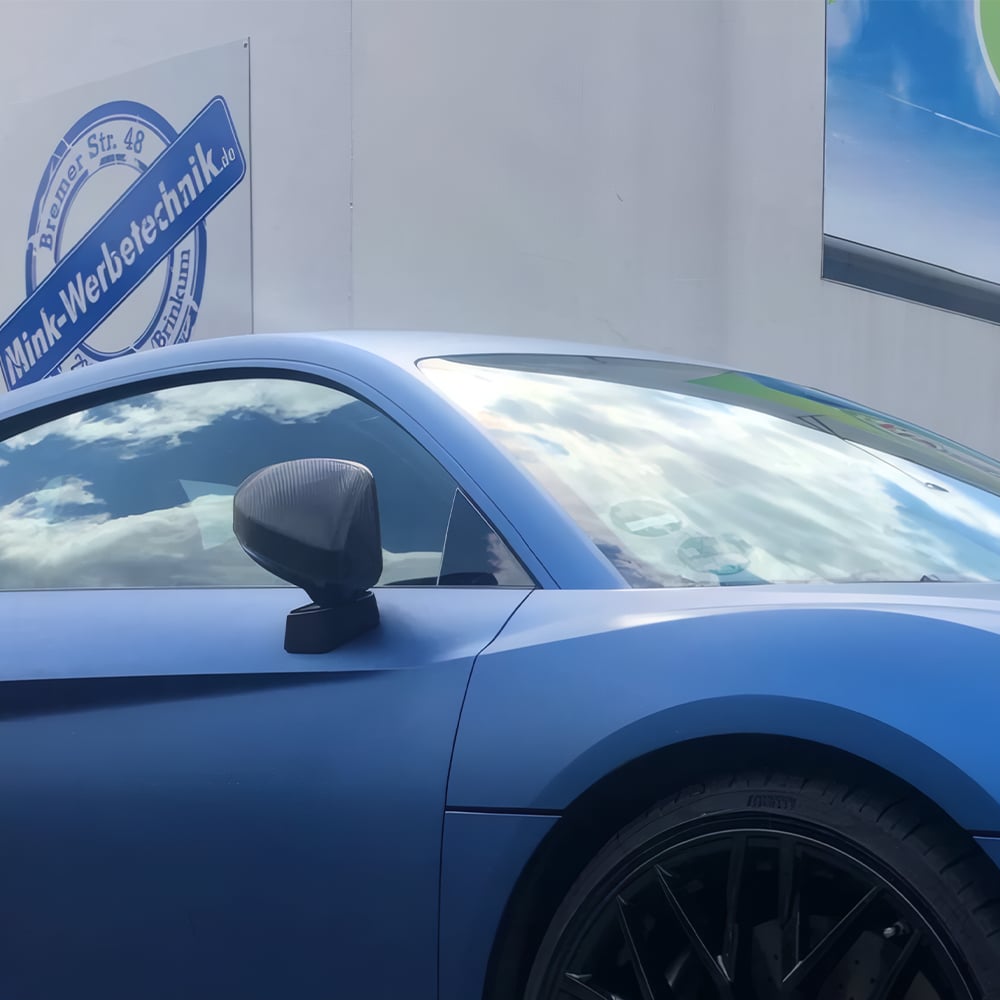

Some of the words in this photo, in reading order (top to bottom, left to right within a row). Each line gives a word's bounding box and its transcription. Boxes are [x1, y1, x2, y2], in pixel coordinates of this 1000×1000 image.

[39, 153, 86, 251] Bremer
[87, 130, 117, 158] Str.
[123, 127, 145, 153] 48
